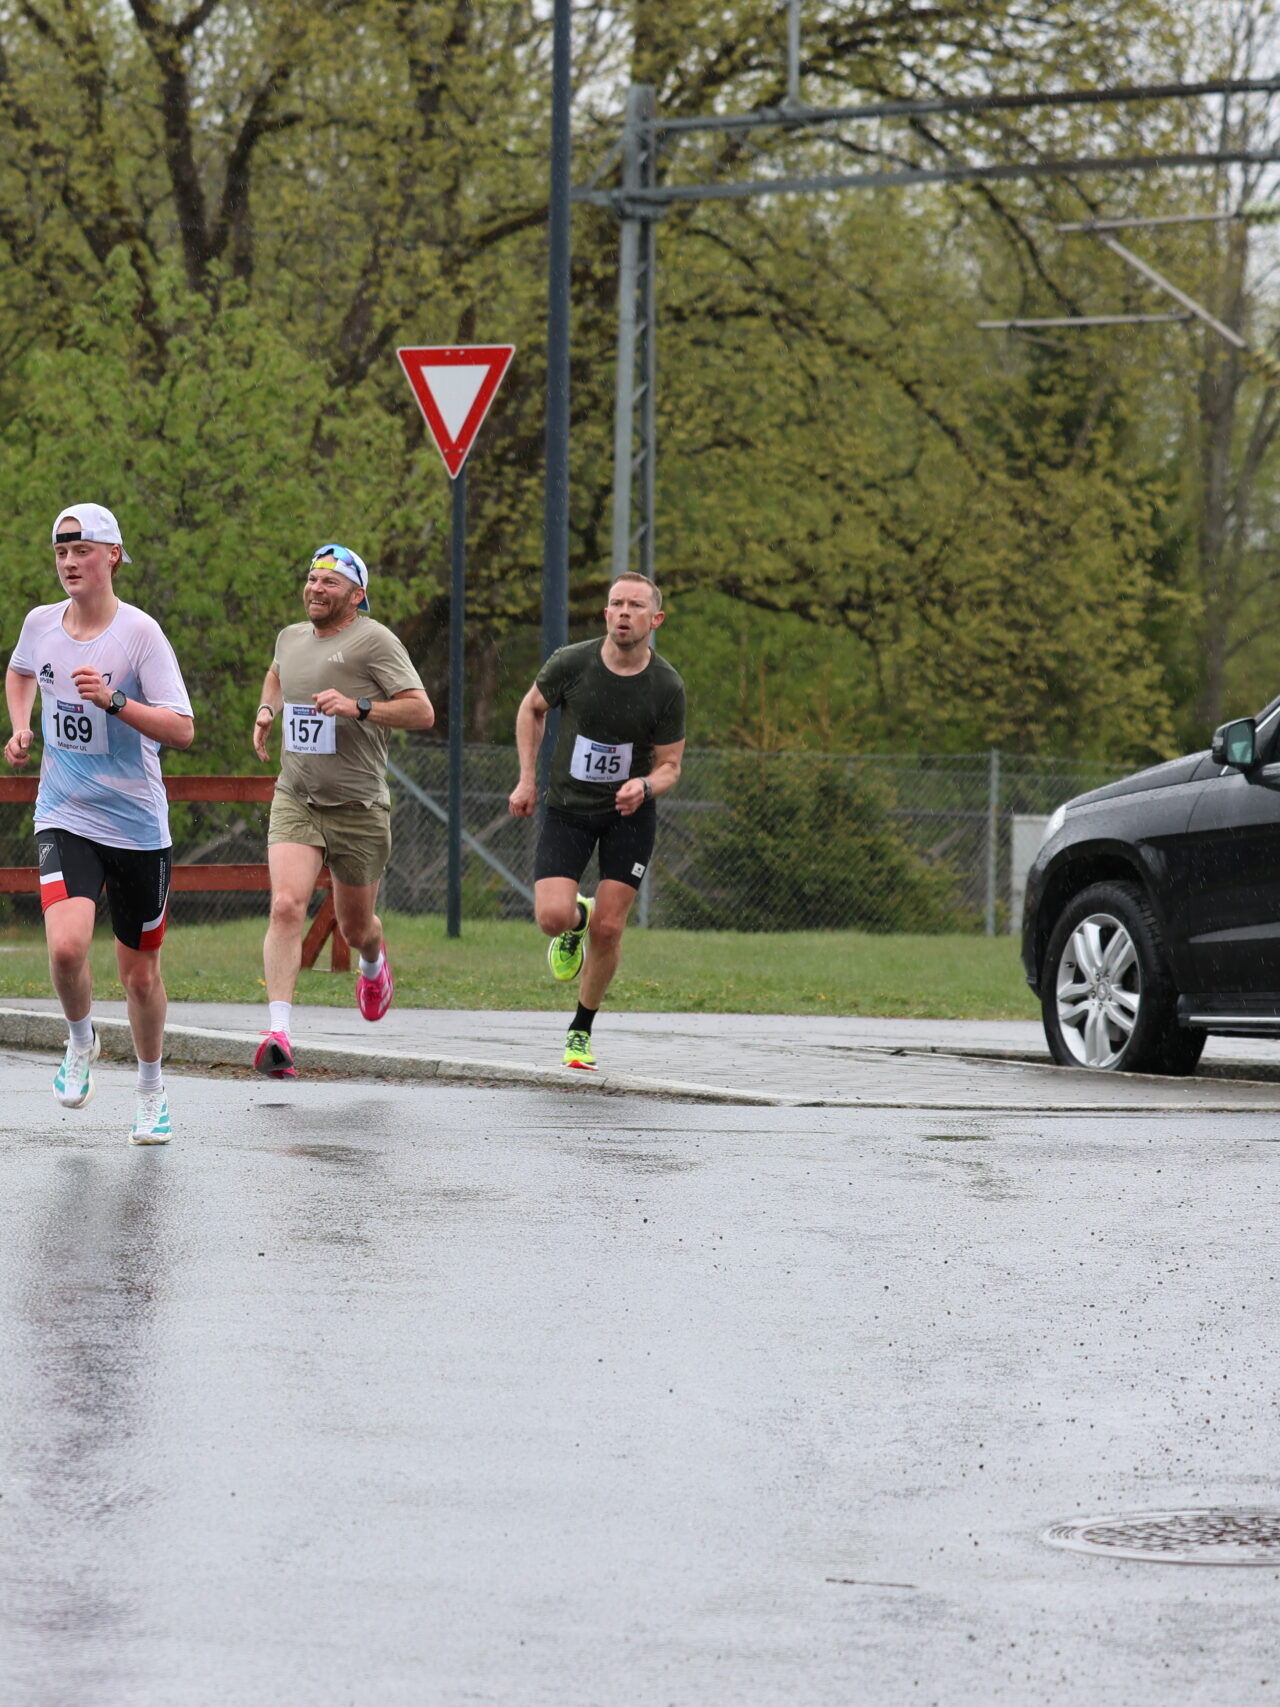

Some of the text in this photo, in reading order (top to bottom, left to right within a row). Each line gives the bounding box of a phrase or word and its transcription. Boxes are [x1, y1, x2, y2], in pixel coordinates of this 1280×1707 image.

[53, 712, 92, 743] 169
[290, 718, 323, 743] 157
[57, 741, 78, 750] Magnor
[584, 753, 621, 774] 145
